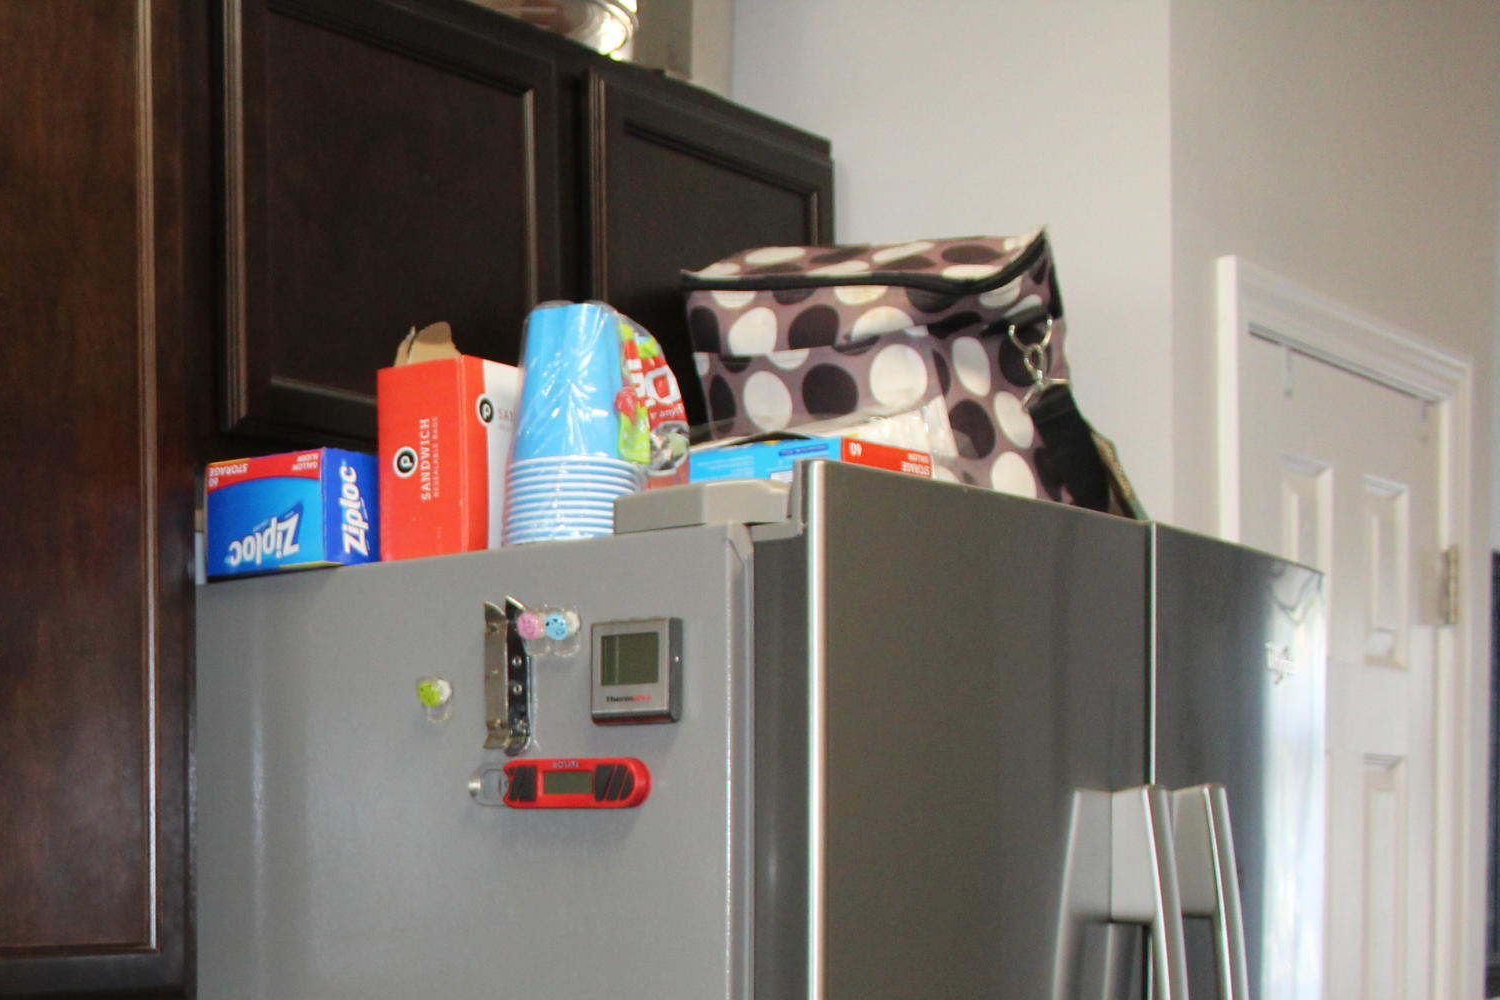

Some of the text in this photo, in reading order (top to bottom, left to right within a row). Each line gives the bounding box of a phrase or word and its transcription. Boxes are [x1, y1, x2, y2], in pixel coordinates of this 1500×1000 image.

[209, 463, 249, 477] STORAGE
[420, 418, 431, 501] SANDWICH
[901, 461, 930, 475] STORAGE
[339, 465, 370, 557] Ziploc
[228, 512, 300, 567] Ziploc
